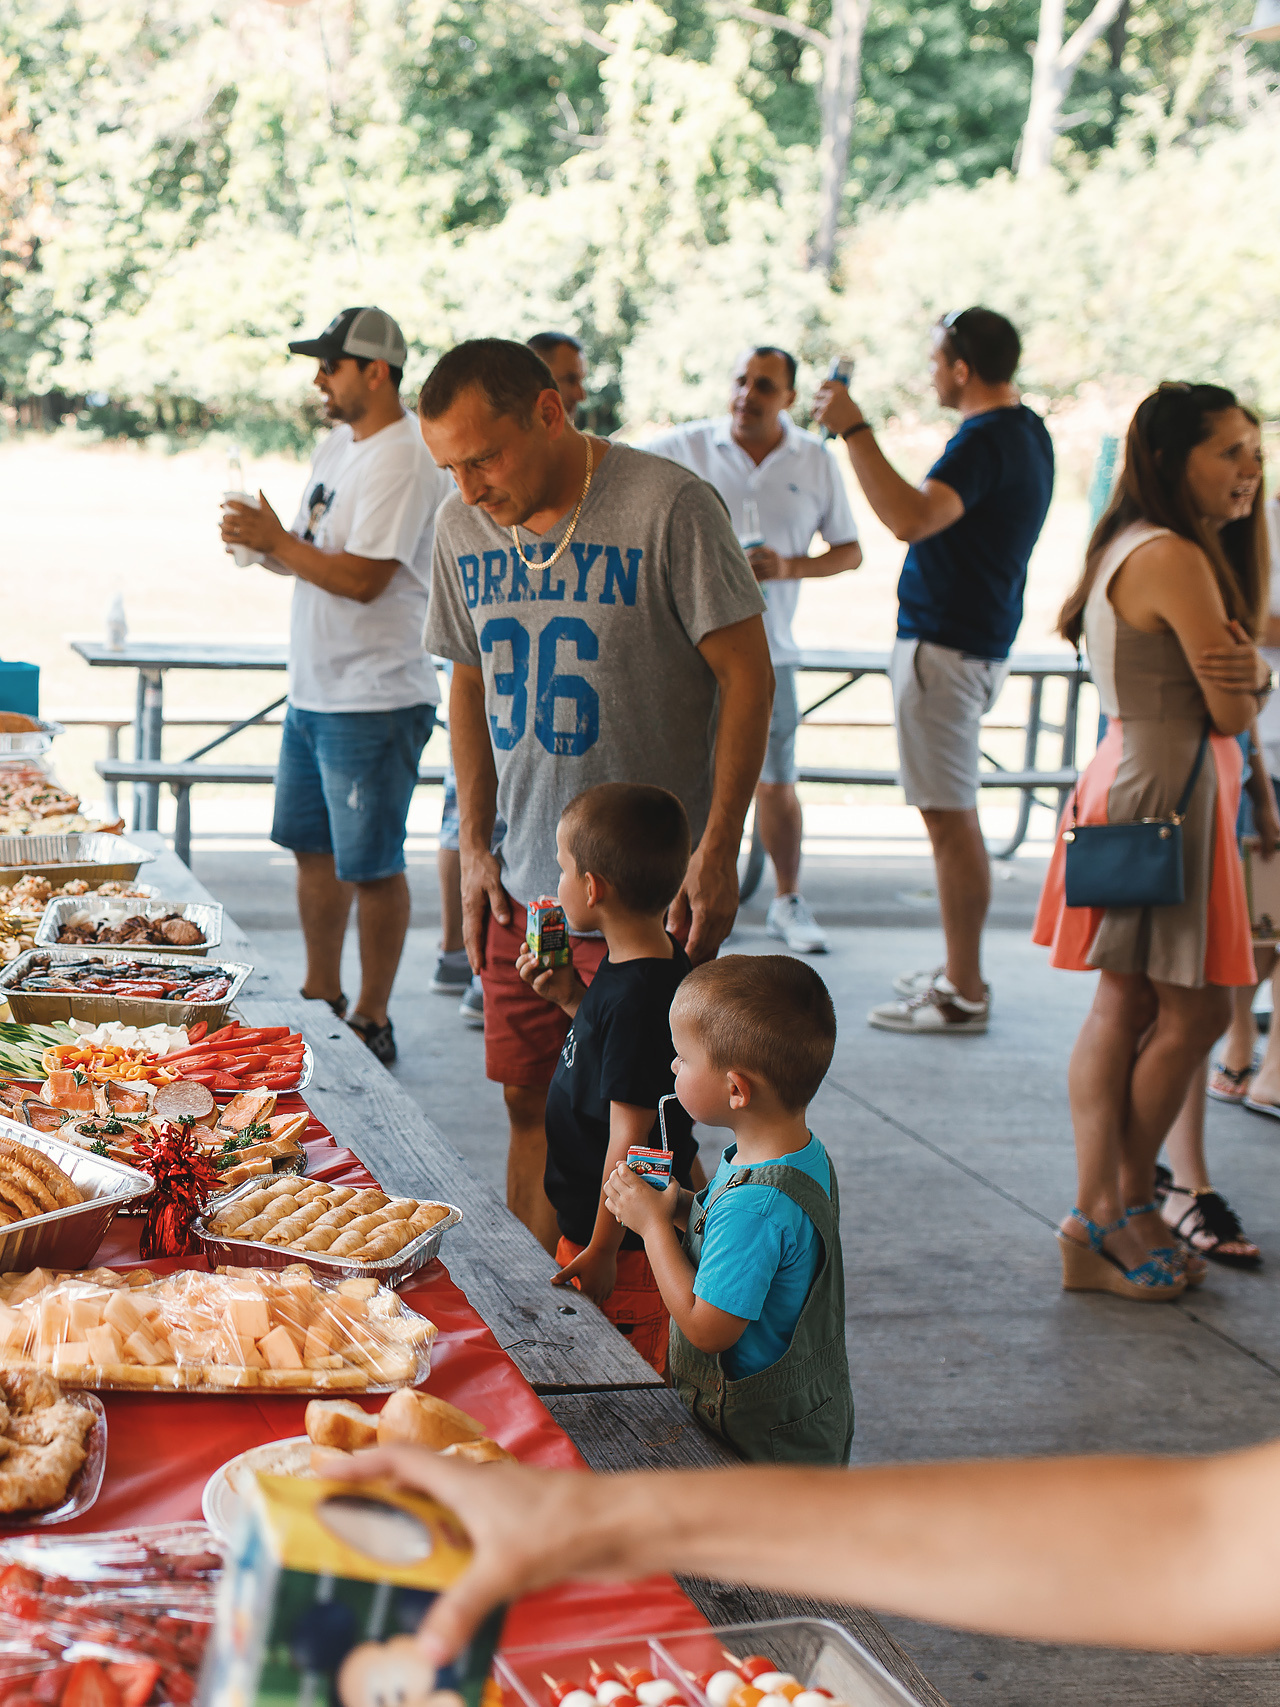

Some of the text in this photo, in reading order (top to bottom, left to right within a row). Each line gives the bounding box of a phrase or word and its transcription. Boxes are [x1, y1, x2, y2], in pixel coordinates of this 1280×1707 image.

[457, 541, 643, 608] BRKLYN
[480, 616, 599, 757] 36
[553, 737, 575, 753] NY
